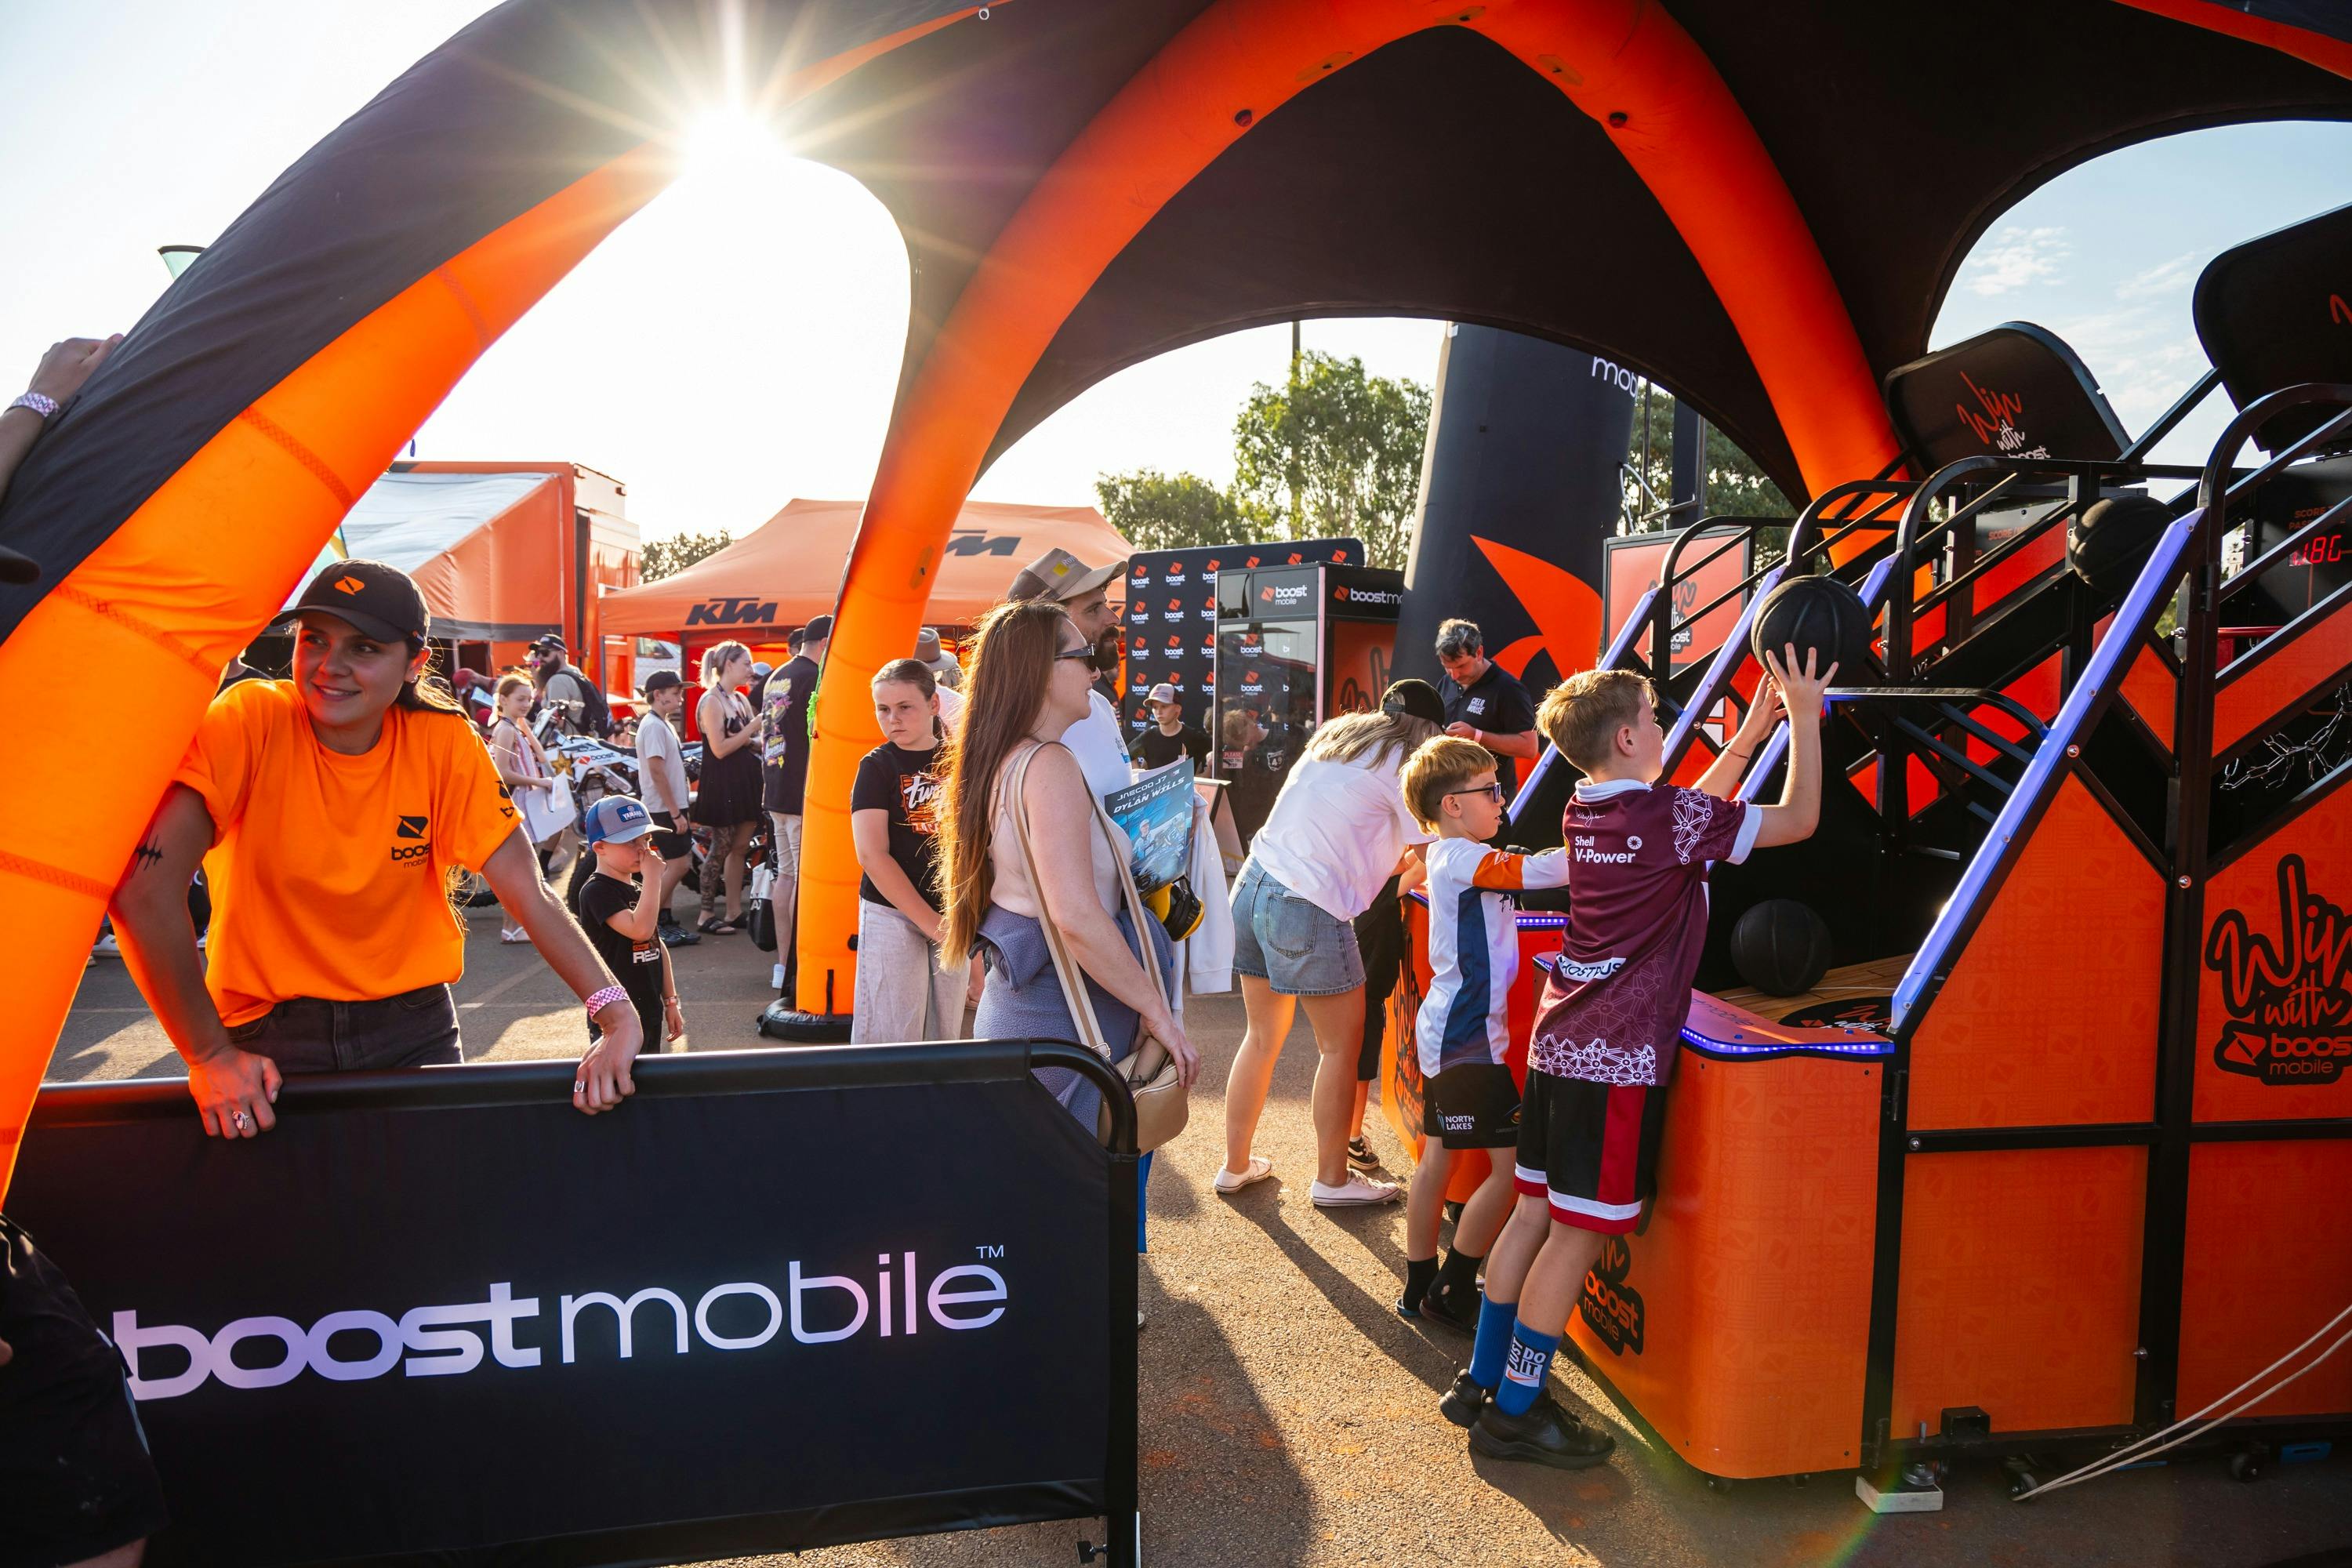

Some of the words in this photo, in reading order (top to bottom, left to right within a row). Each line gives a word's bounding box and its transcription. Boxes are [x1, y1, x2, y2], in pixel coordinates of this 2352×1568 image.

[1957, 371, 2023, 445] Win
[1131, 577, 1149, 586] boost
[1166, 574, 1185, 583] boost
[1276, 585, 1307, 598] boost
[685, 597, 778, 626] KTM
[1113, 793, 1149, 814] DYLAN
[1152, 776, 1185, 797] WILLS
[1575, 836, 1595, 847] Shell
[391, 842, 430, 861] boos
[1575, 848, 1636, 864] V-Power
[2265, 969, 2343, 1027] with
[2271, 1033, 2352, 1058] boos
[2270, 1059, 2333, 1075] mobile
[1584, 1296, 1619, 1341] mobile
[1508, 1336, 1523, 1370] JUST
[1523, 1347, 1546, 1364] DO
[1523, 1361, 1539, 1377] IT
